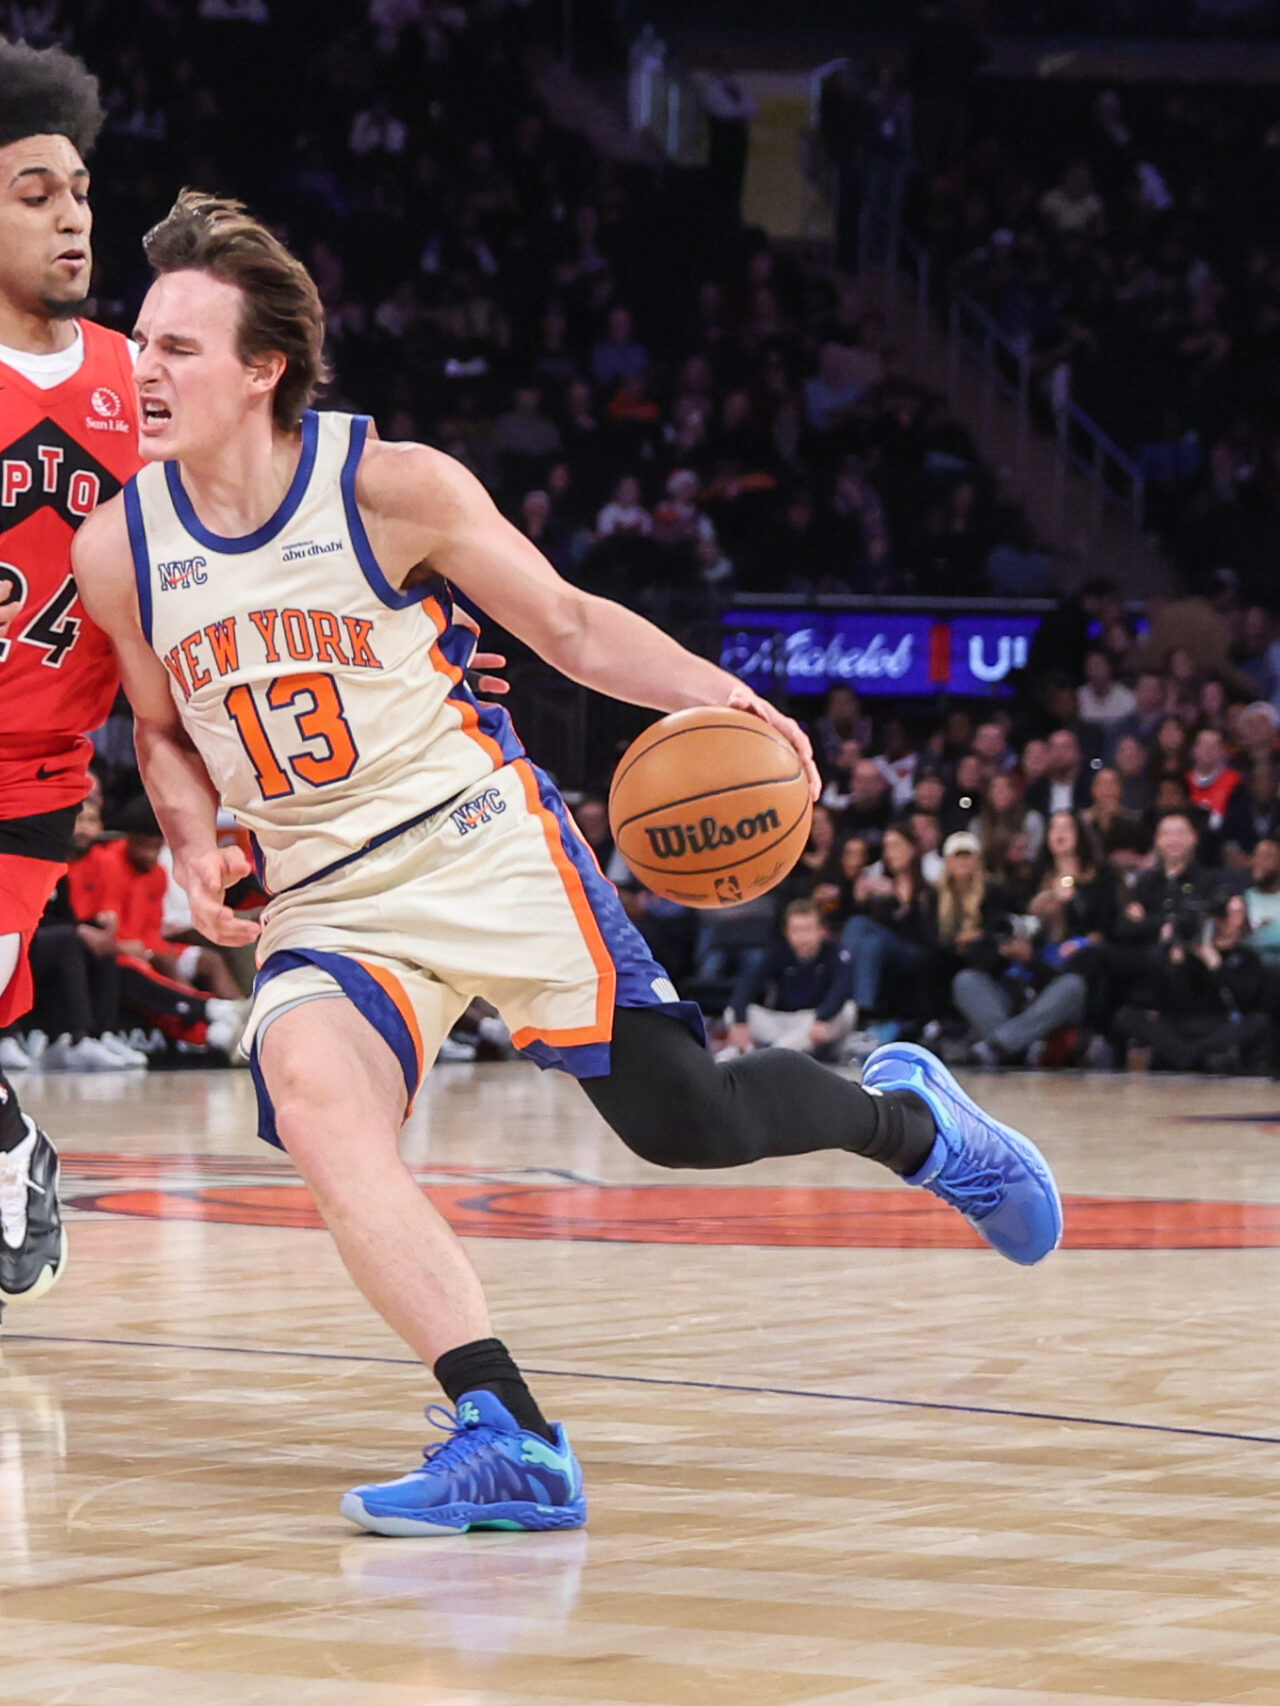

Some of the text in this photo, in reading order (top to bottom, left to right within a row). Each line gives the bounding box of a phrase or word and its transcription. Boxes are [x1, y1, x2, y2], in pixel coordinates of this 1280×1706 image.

[86, 416, 130, 434] Sun Life
[158, 556, 208, 591] NYC
[282, 539, 343, 562] abu dhabi
[164, 608, 384, 704] NEW YORK
[223, 672, 360, 800] 13
[449, 787, 507, 836] NYC
[644, 807, 782, 859] Wilson
